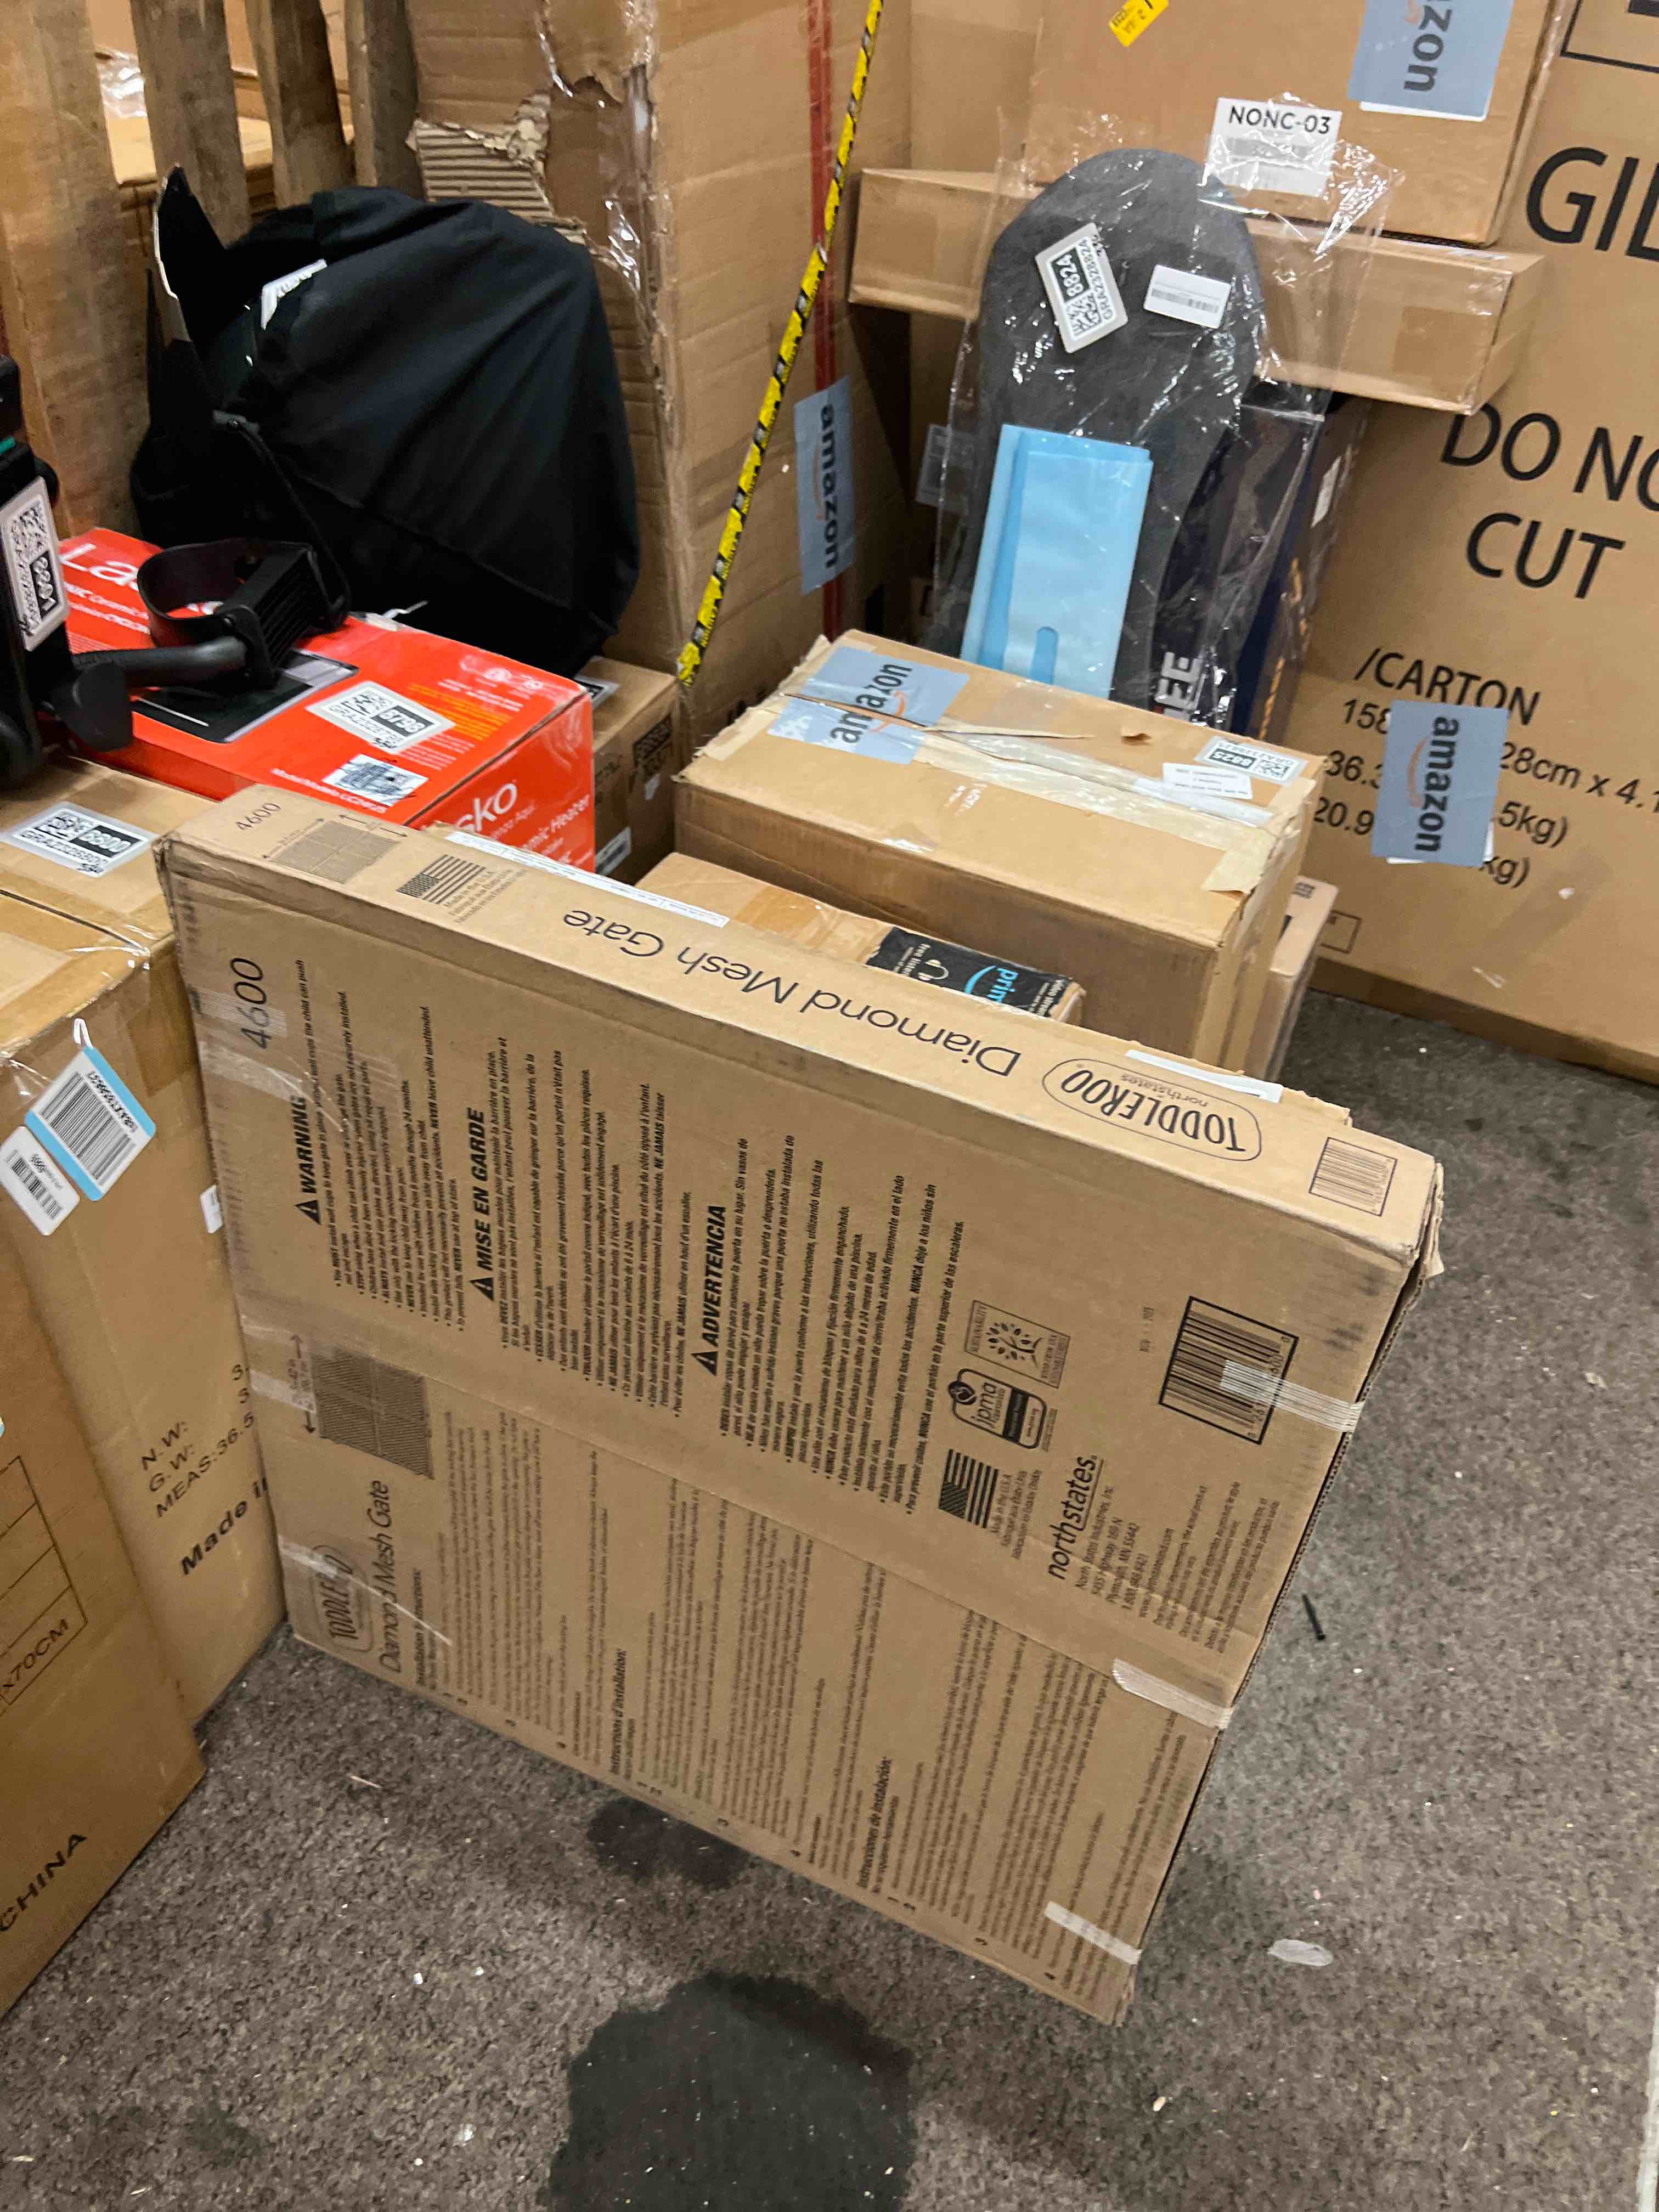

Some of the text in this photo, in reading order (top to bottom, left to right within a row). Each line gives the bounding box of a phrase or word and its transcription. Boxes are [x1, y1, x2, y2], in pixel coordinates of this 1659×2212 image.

[1403, 0, 1453, 92] zon
[1228, 105, 1332, 135] NONC-03
[1441, 403, 1562, 481] DO
[821, 403, 840, 569] amazon
[1466, 512, 1626, 600] CUT
[830, 660, 914, 745] amazon
[1354, 647, 1541, 726] /CARTON
[1414, 715, 1461, 853] amazon
[1585, 774, 1611, 797] x
[235, 802, 282, 832] 4600
[563, 909, 665, 957] Gate
[676, 946, 799, 1005] Mesh
[229, 957, 273, 1049] 4600
[800, 989, 1022, 1079] Diamond
[425, 1056, 435, 1078] child
[428, 1077, 436, 1101] leave
[489, 1090, 498, 1125] barrière
[656, 1092, 664, 1121] laisser
[1060, 1069, 1246, 1153] TODDLEROO
[1120, 1073, 1207, 1107] northstates
[428, 1101, 438, 1130] NEVER
[291, 1098, 317, 1193] WARNING
[492, 1135, 501, 1176] maintenir
[654, 1121, 664, 1156] JAMAIS
[735, 1175, 745, 1190] Sin
[738, 1150, 747, 1175] vasos
[781, 1146, 793, 1187] instalada
[467, 1108, 493, 1271] MISE EN GARDE
[779, 1186, 790, 1216] estaba
[922, 1198, 934, 1223] niños
[926, 1182, 936, 1198] sin
[919, 1222, 930, 1238] los
[702, 1206, 726, 1346] ADVERTENCIA
[915, 1244, 927, 1264] deje
[909, 1263, 923, 1294] NUNCA
[938, 1288, 952, 1323] superior
[945, 1262, 956, 1277] las
[972, 1383, 1005, 1428] jpma
[367, 1480, 392, 1528] Gate
[181, 1500, 248, 1575] Made
[369, 1533, 395, 1586] Mesh
[0, 1832, 87, 1932] CHINA
